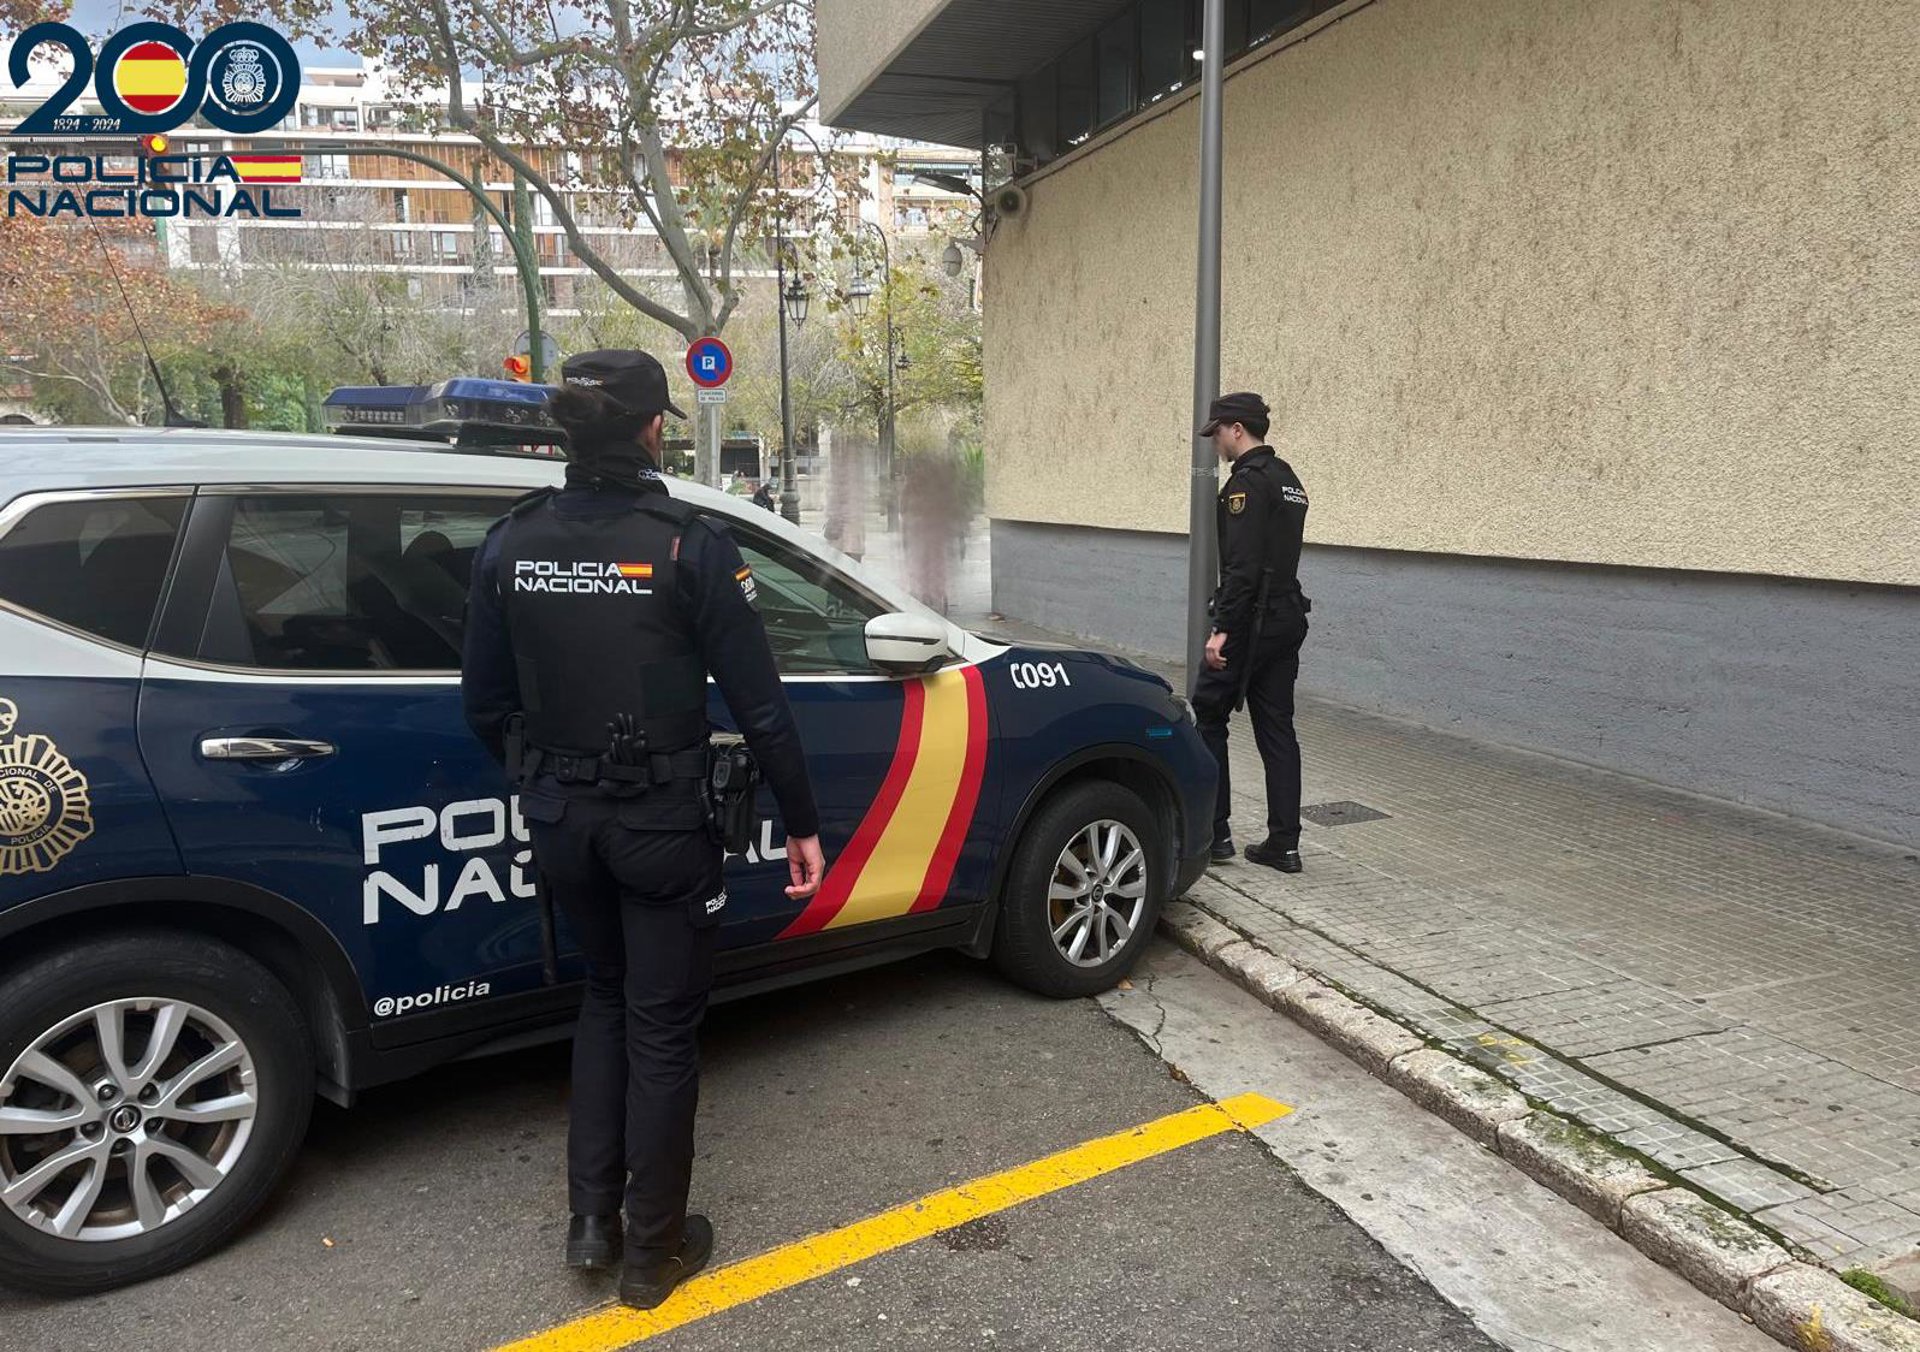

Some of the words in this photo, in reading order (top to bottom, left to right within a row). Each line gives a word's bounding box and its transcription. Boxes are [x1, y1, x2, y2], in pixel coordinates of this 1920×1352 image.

[514, 560, 623, 577] POLICIA
[514, 576, 653, 595] NACIONAL
[1021, 662, 1071, 689] 091
[0, 767, 38, 779] CIONAL
[43, 779, 58, 793] DE
[11, 824, 51, 845] POLICIA
[373, 981, 490, 1017] @policia
